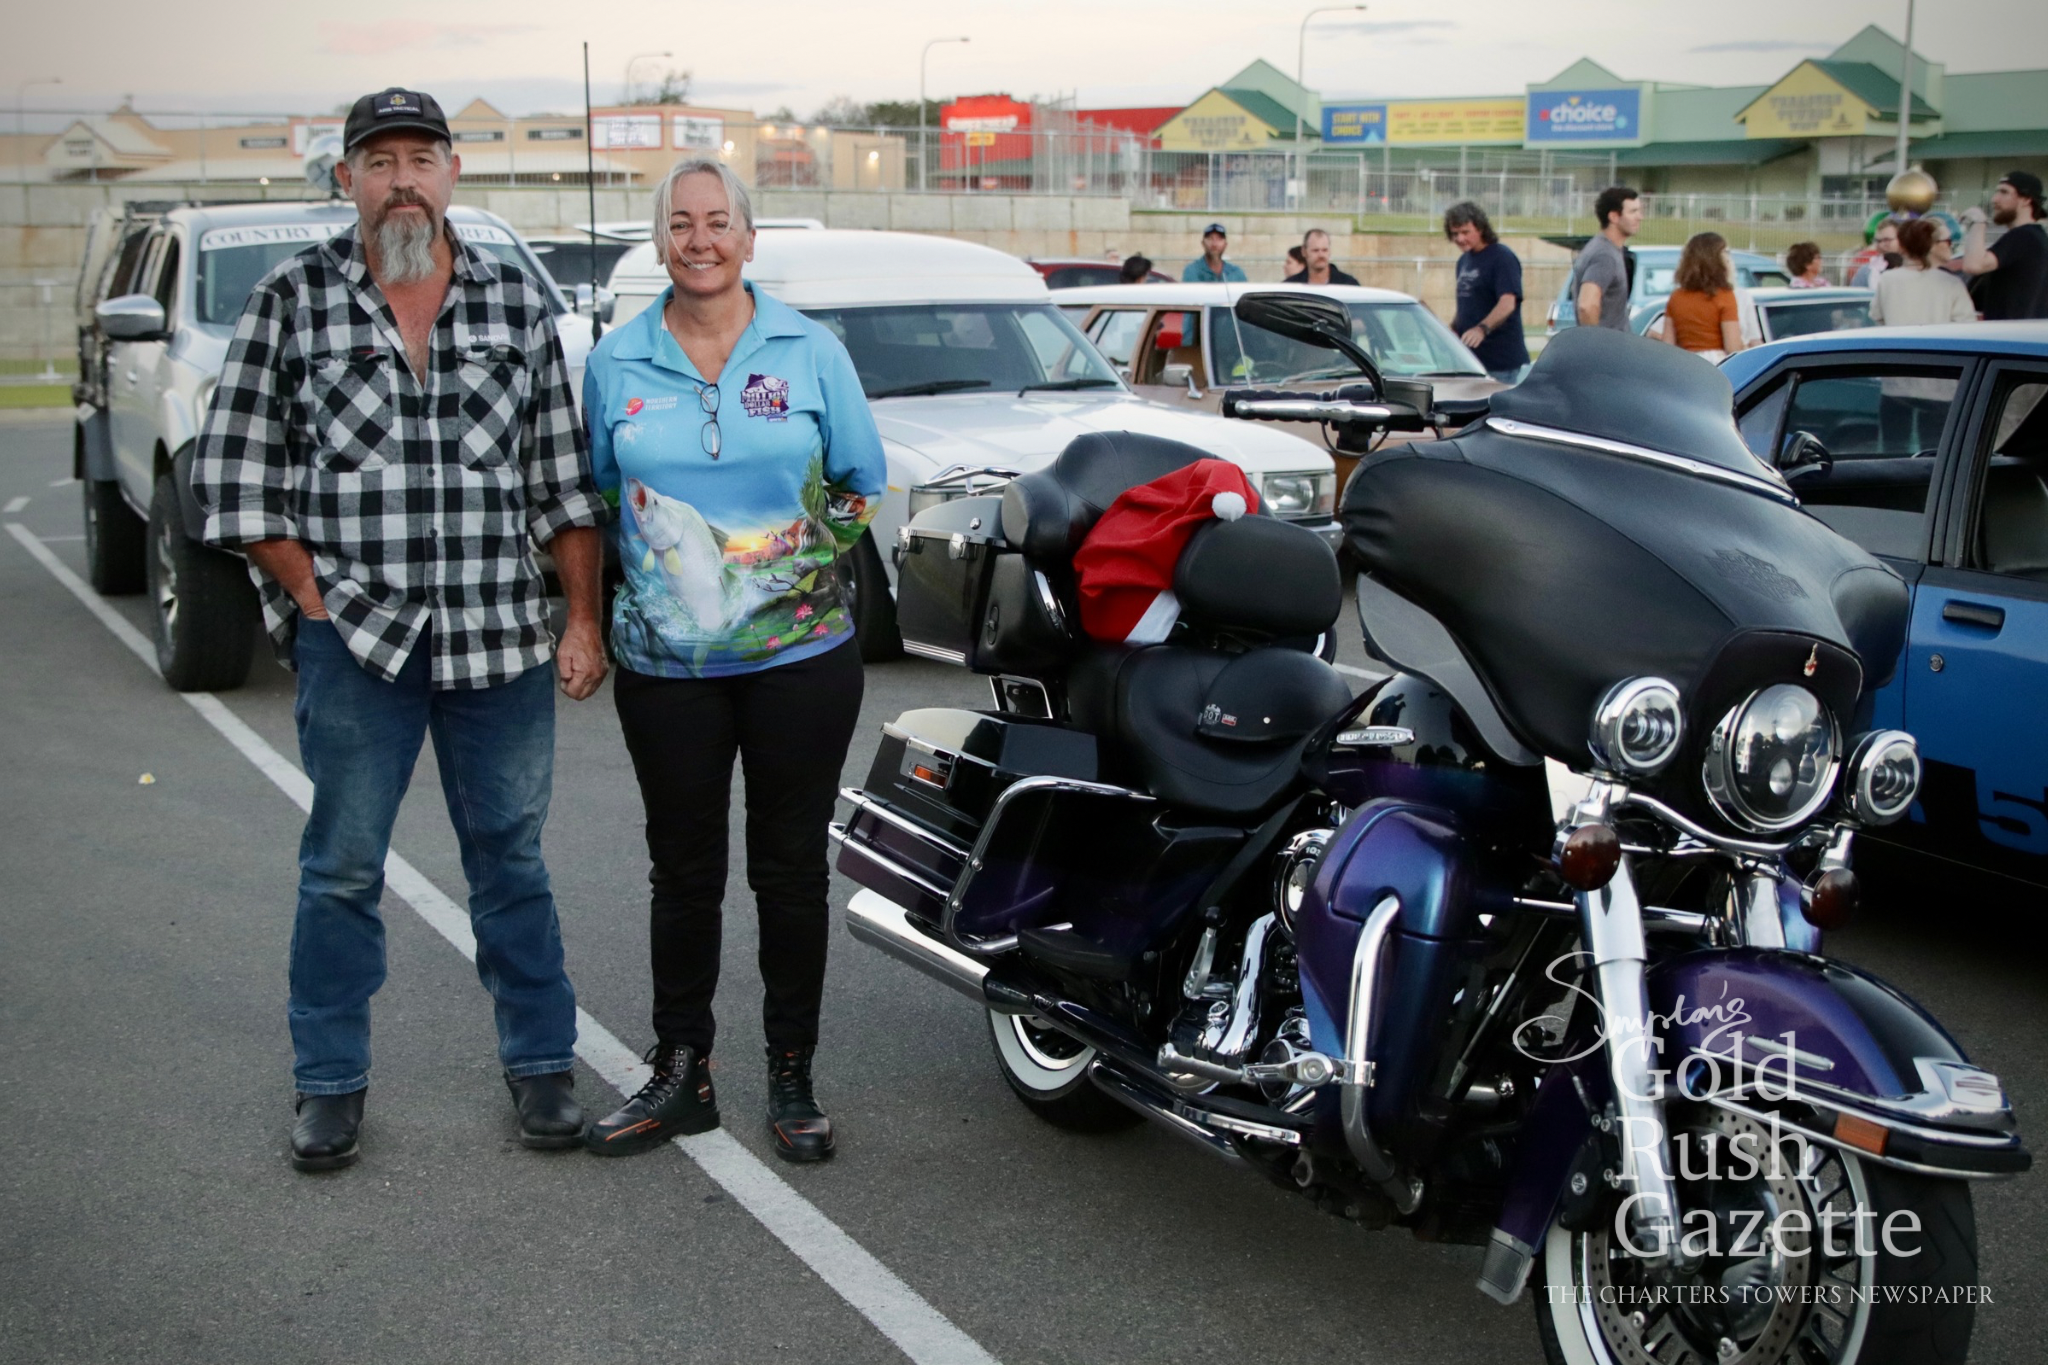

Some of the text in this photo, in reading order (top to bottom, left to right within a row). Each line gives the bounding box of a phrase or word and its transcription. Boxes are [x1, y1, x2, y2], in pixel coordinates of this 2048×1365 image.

[1550, 101, 1617, 122] choice
[206, 226, 312, 247] COUNTRY
[741, 390, 788, 403] MILLION
[744, 401, 771, 409] DOLLAR
